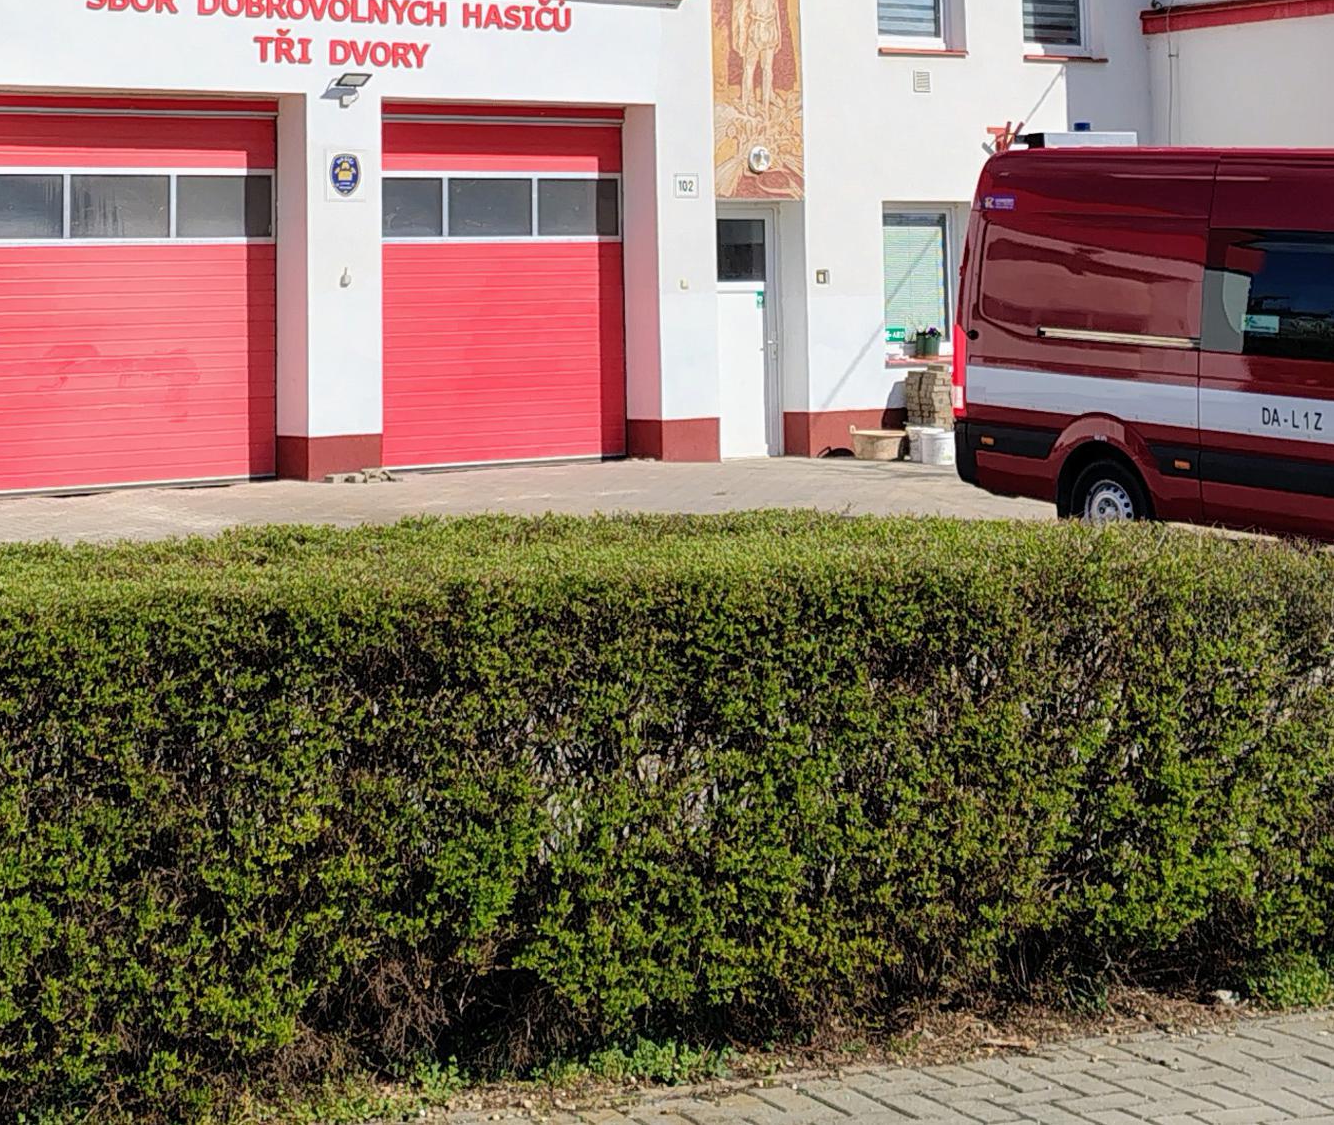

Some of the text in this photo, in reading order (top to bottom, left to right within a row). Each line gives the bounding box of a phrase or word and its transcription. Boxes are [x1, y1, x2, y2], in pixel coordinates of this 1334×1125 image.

[254, 29, 431, 68] TŘI DVORY
[678, 179, 694, 192] 102
